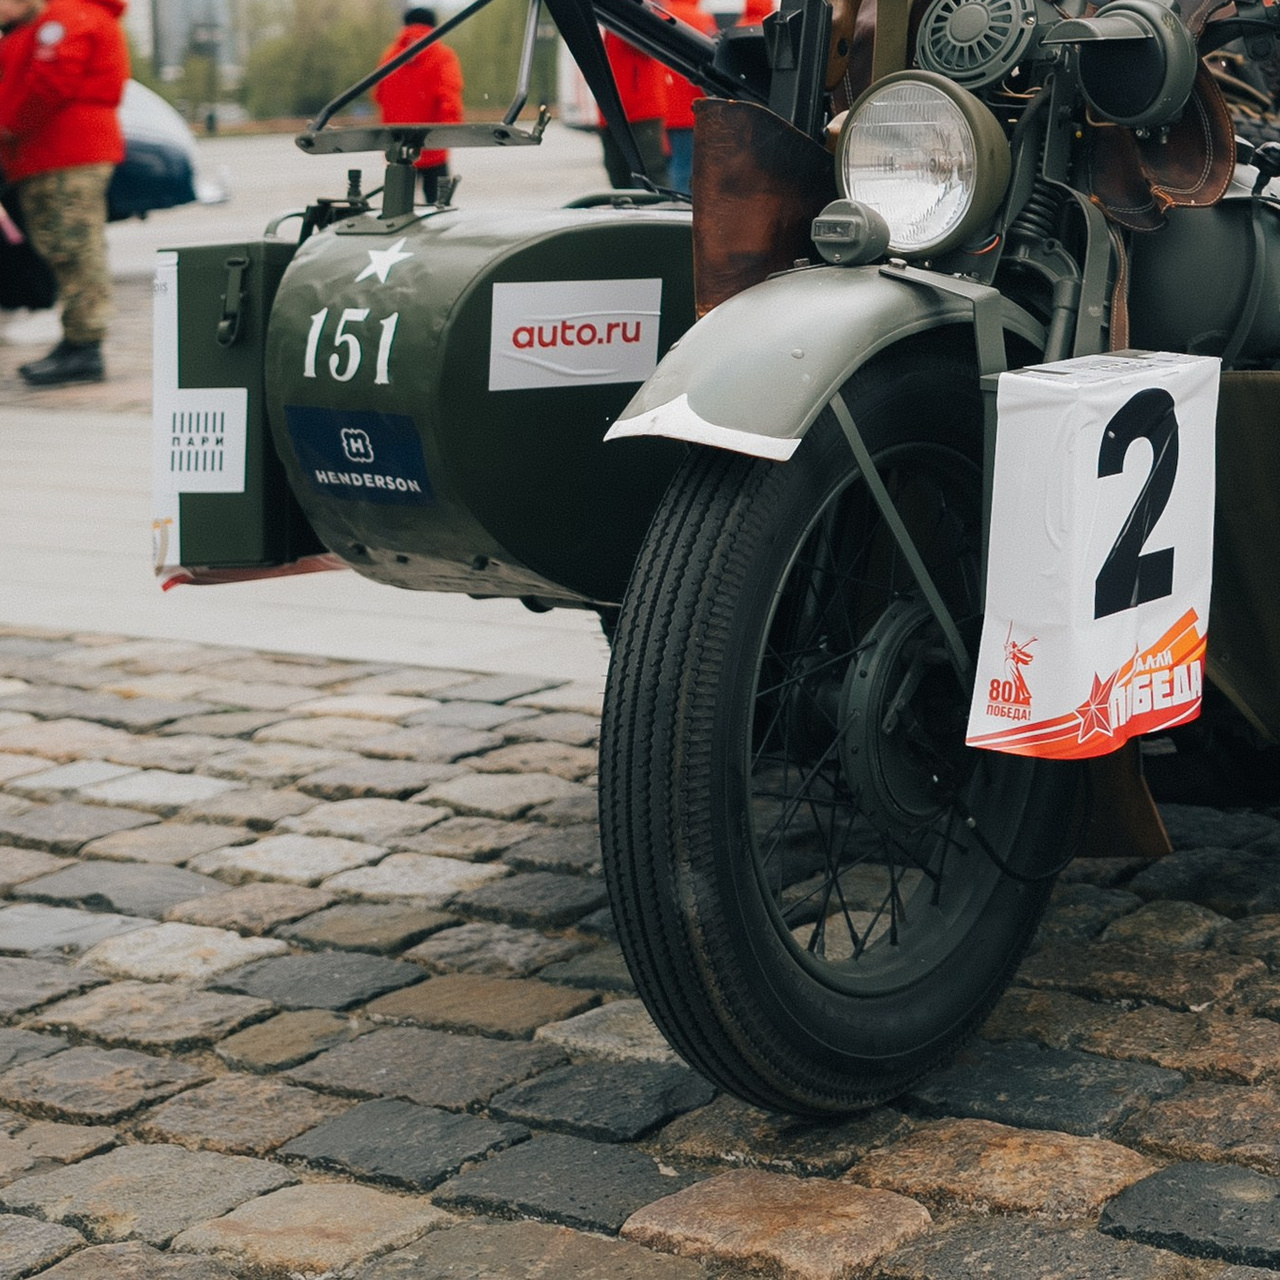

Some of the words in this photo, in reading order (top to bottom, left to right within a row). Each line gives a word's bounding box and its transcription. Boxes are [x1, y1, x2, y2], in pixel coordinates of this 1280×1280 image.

[303, 306, 399, 385] 151
[512, 320, 641, 349] auto.ru
[172, 436, 224, 447] ПАРИ
[315, 470, 422, 493] HENDERSON
[1093, 387, 1179, 620] 2
[1135, 649, 1173, 671] АЛЛИ
[989, 678, 1013, 703] 80
[986, 704, 1031, 721] ПОБЕДА!
